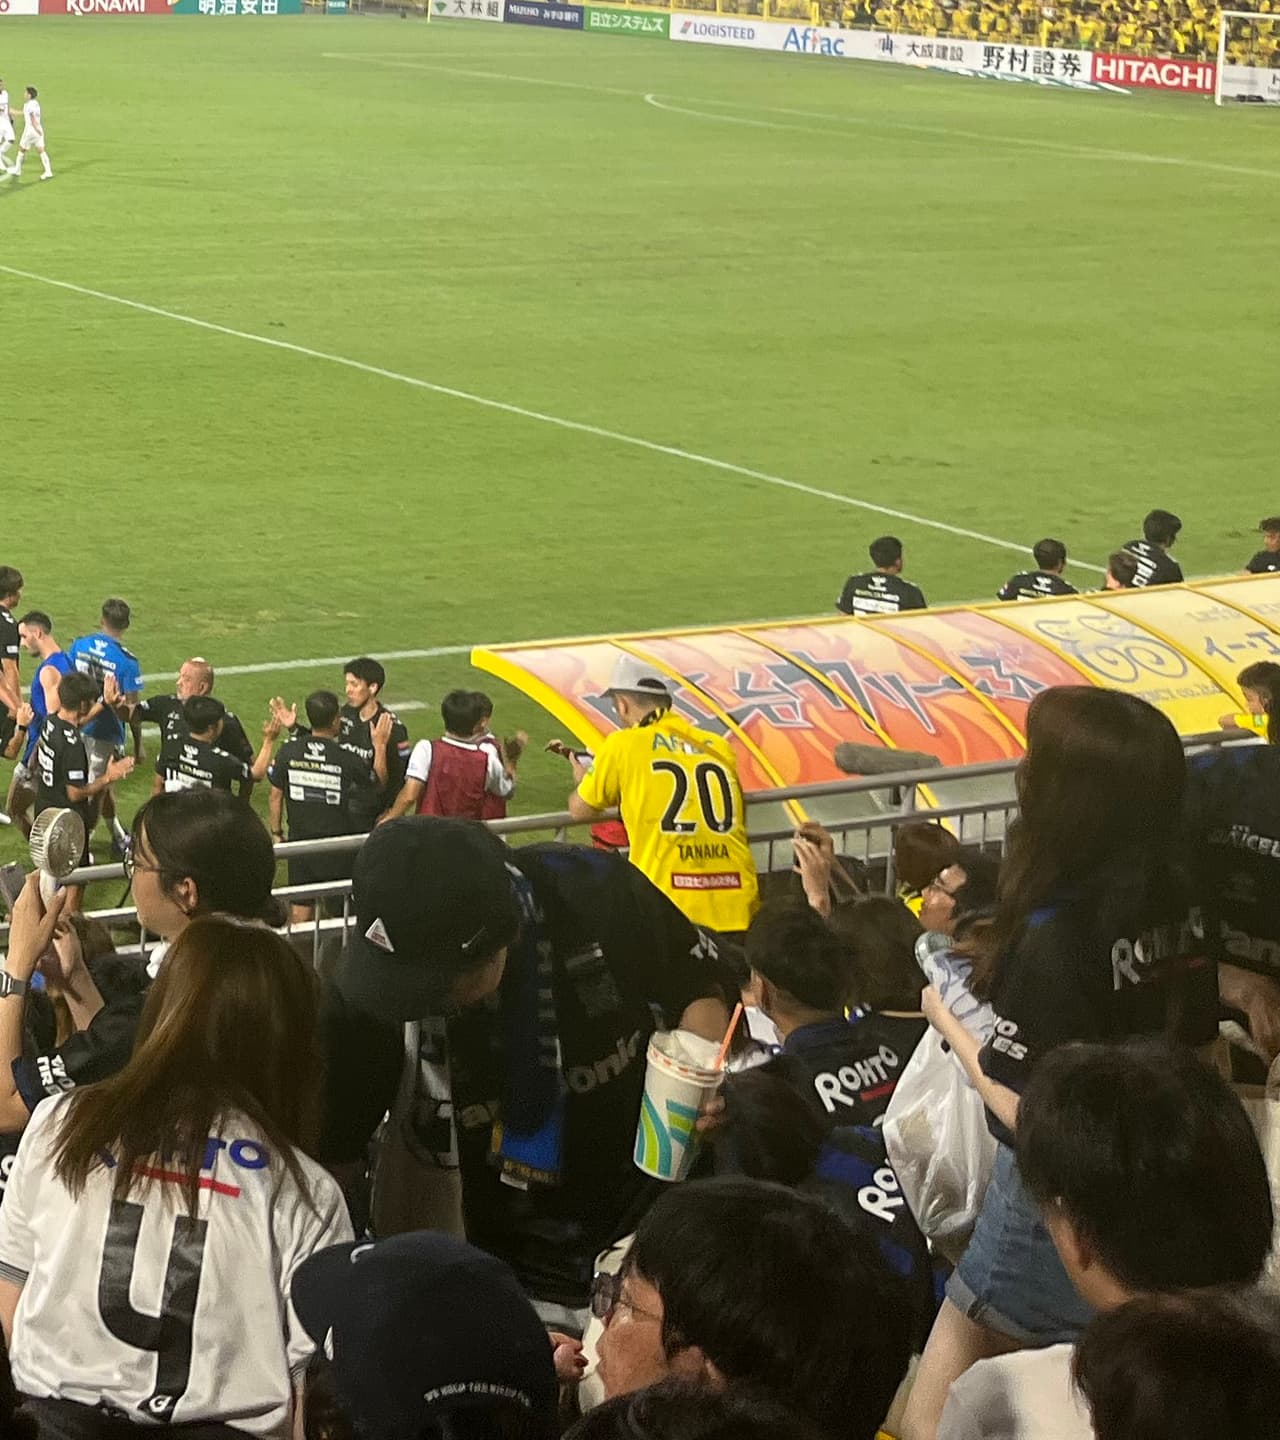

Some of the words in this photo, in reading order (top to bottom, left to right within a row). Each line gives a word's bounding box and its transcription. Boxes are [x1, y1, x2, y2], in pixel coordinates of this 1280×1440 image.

[509, 4, 539, 17] MIZUHO
[590, 12, 664, 33] 日立システムズ
[693, 22, 755, 41] LOGISTEED
[784, 27, 845, 56] Aflac
[906, 43, 964, 63] 大成建設
[983, 45, 1082, 77] 野村證券
[1096, 57, 1213, 90] HITACHI
[651, 761, 734, 833] 20
[677, 844, 730, 860] TANAKA
[814, 1045, 899, 1113] ROHTO
[97, 1200, 209, 1423] 4
